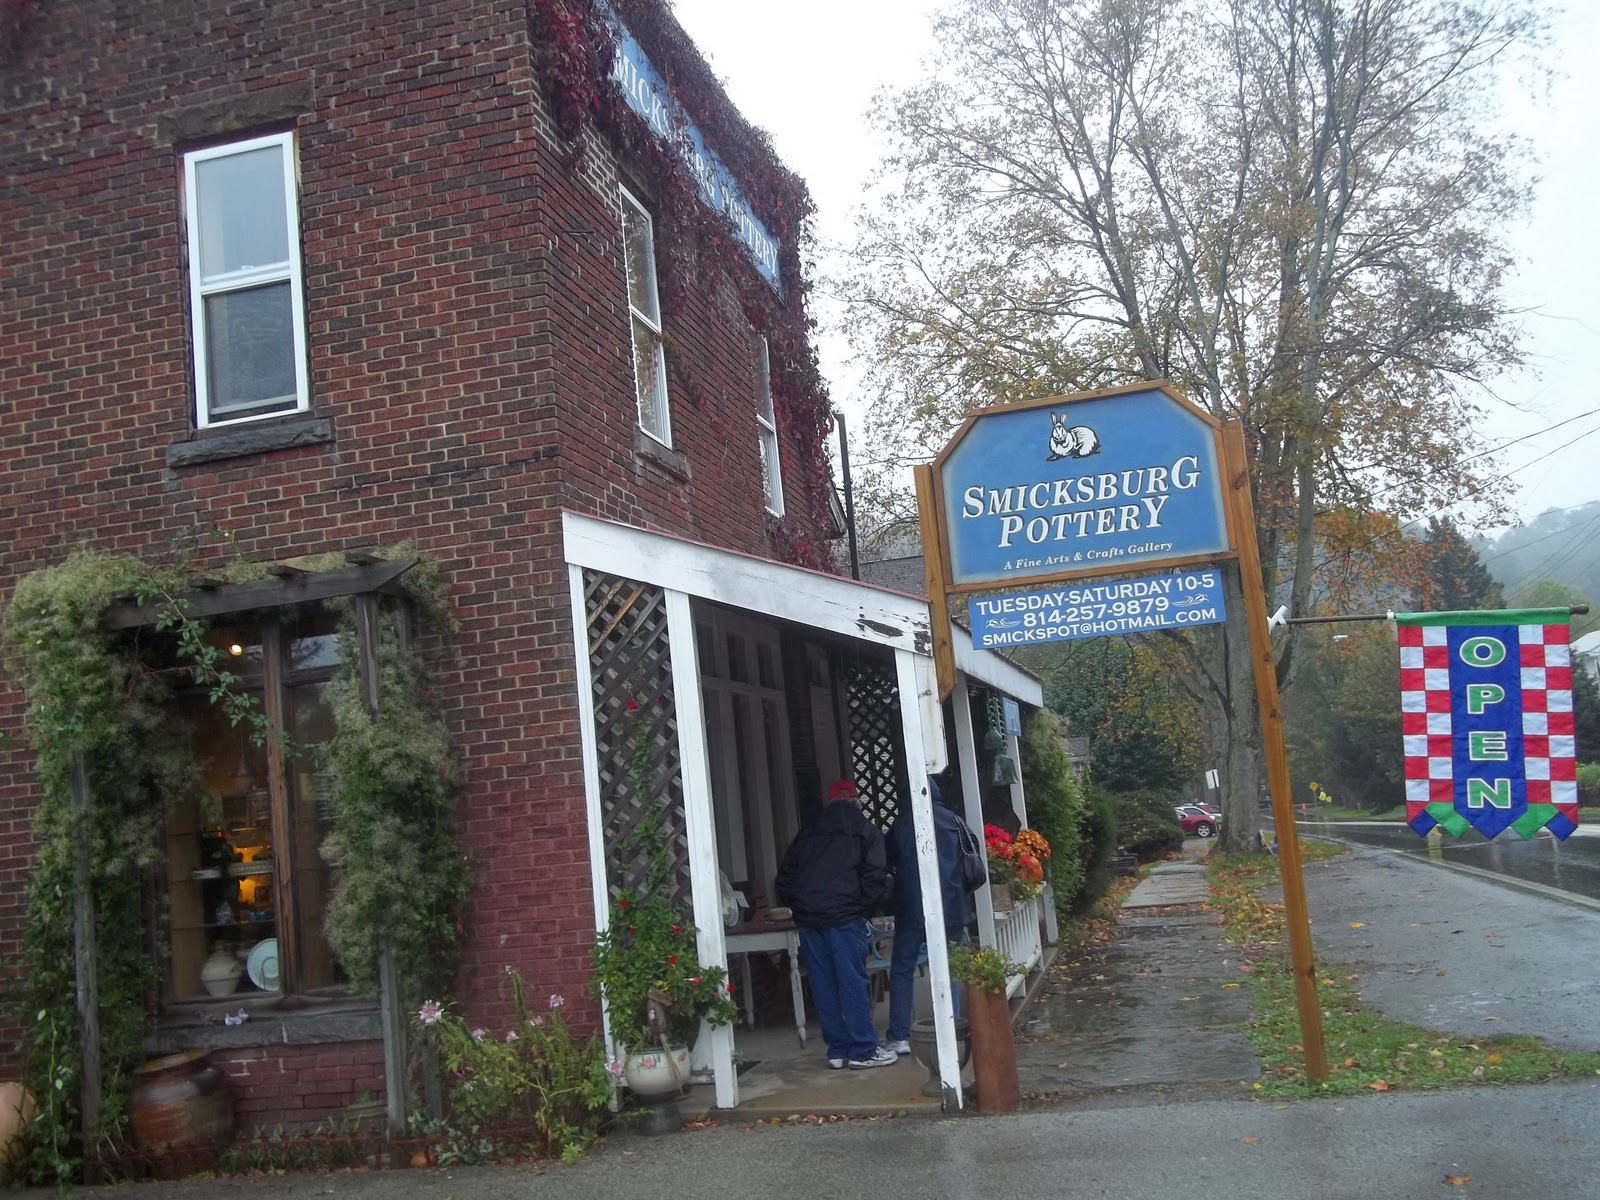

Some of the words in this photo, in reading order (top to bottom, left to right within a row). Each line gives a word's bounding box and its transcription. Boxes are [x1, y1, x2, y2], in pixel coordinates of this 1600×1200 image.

[962, 455, 1201, 519] SMICKSBURG
[997, 495, 1170, 548] POTTERY
[1003, 560, 1013, 571] A
[1015, 557, 1042, 570] Fine
[1045, 554, 1070, 565] Arts
[1073, 551, 1084, 562] &
[1086, 547, 1124, 560] Crafts
[1127, 541, 1173, 556] Gallery
[976, 577, 1173, 616] TUESDAY-SATURDAY
[1175, 573, 1215, 592] 10-5
[1022, 596, 1170, 628] 814-257-9879
[982, 607, 1217, 646] SMICKSPOT@HOTMAIL.COM
[1459, 635, 1512, 809] OPEN
